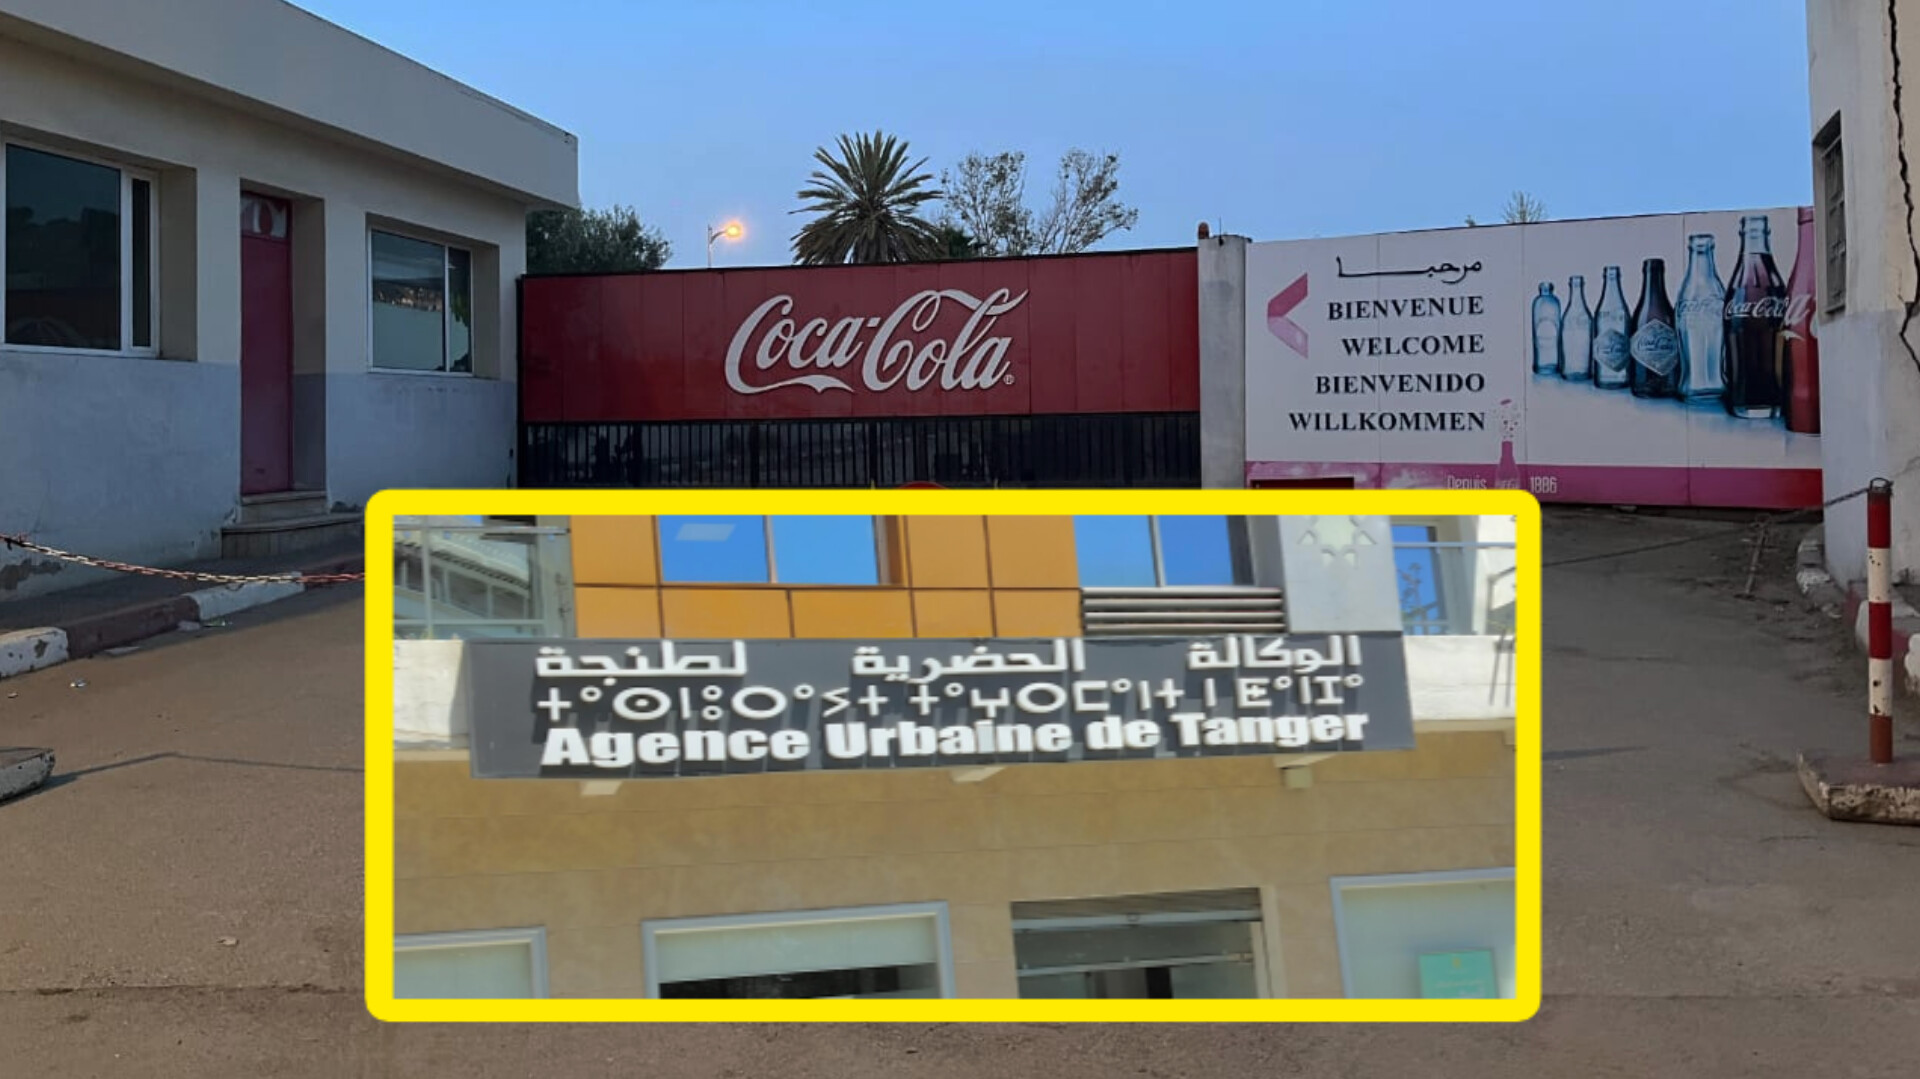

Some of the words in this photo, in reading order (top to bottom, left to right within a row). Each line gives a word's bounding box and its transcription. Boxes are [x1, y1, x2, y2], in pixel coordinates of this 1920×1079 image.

[1336, 256, 1483, 285] مرحبا
[1328, 296, 1485, 321] BIENVENUE
[1342, 334, 1485, 357] WELCOME
[1315, 373, 1486, 394] BIENVENIDO
[1288, 412, 1486, 432] WILLKOMMEN
[1530, 476, 1557, 494] 1886
[535, 640, 747, 686] لطنجة
[852, 638, 1085, 684] الحضرية
[1188, 635, 1362, 673] الوكالة
[541, 727, 811, 768] Agence
[826, 719, 1073, 759] Urbaine
[1086, 715, 1160, 751] de
[1170, 712, 1369, 748] Tanger
